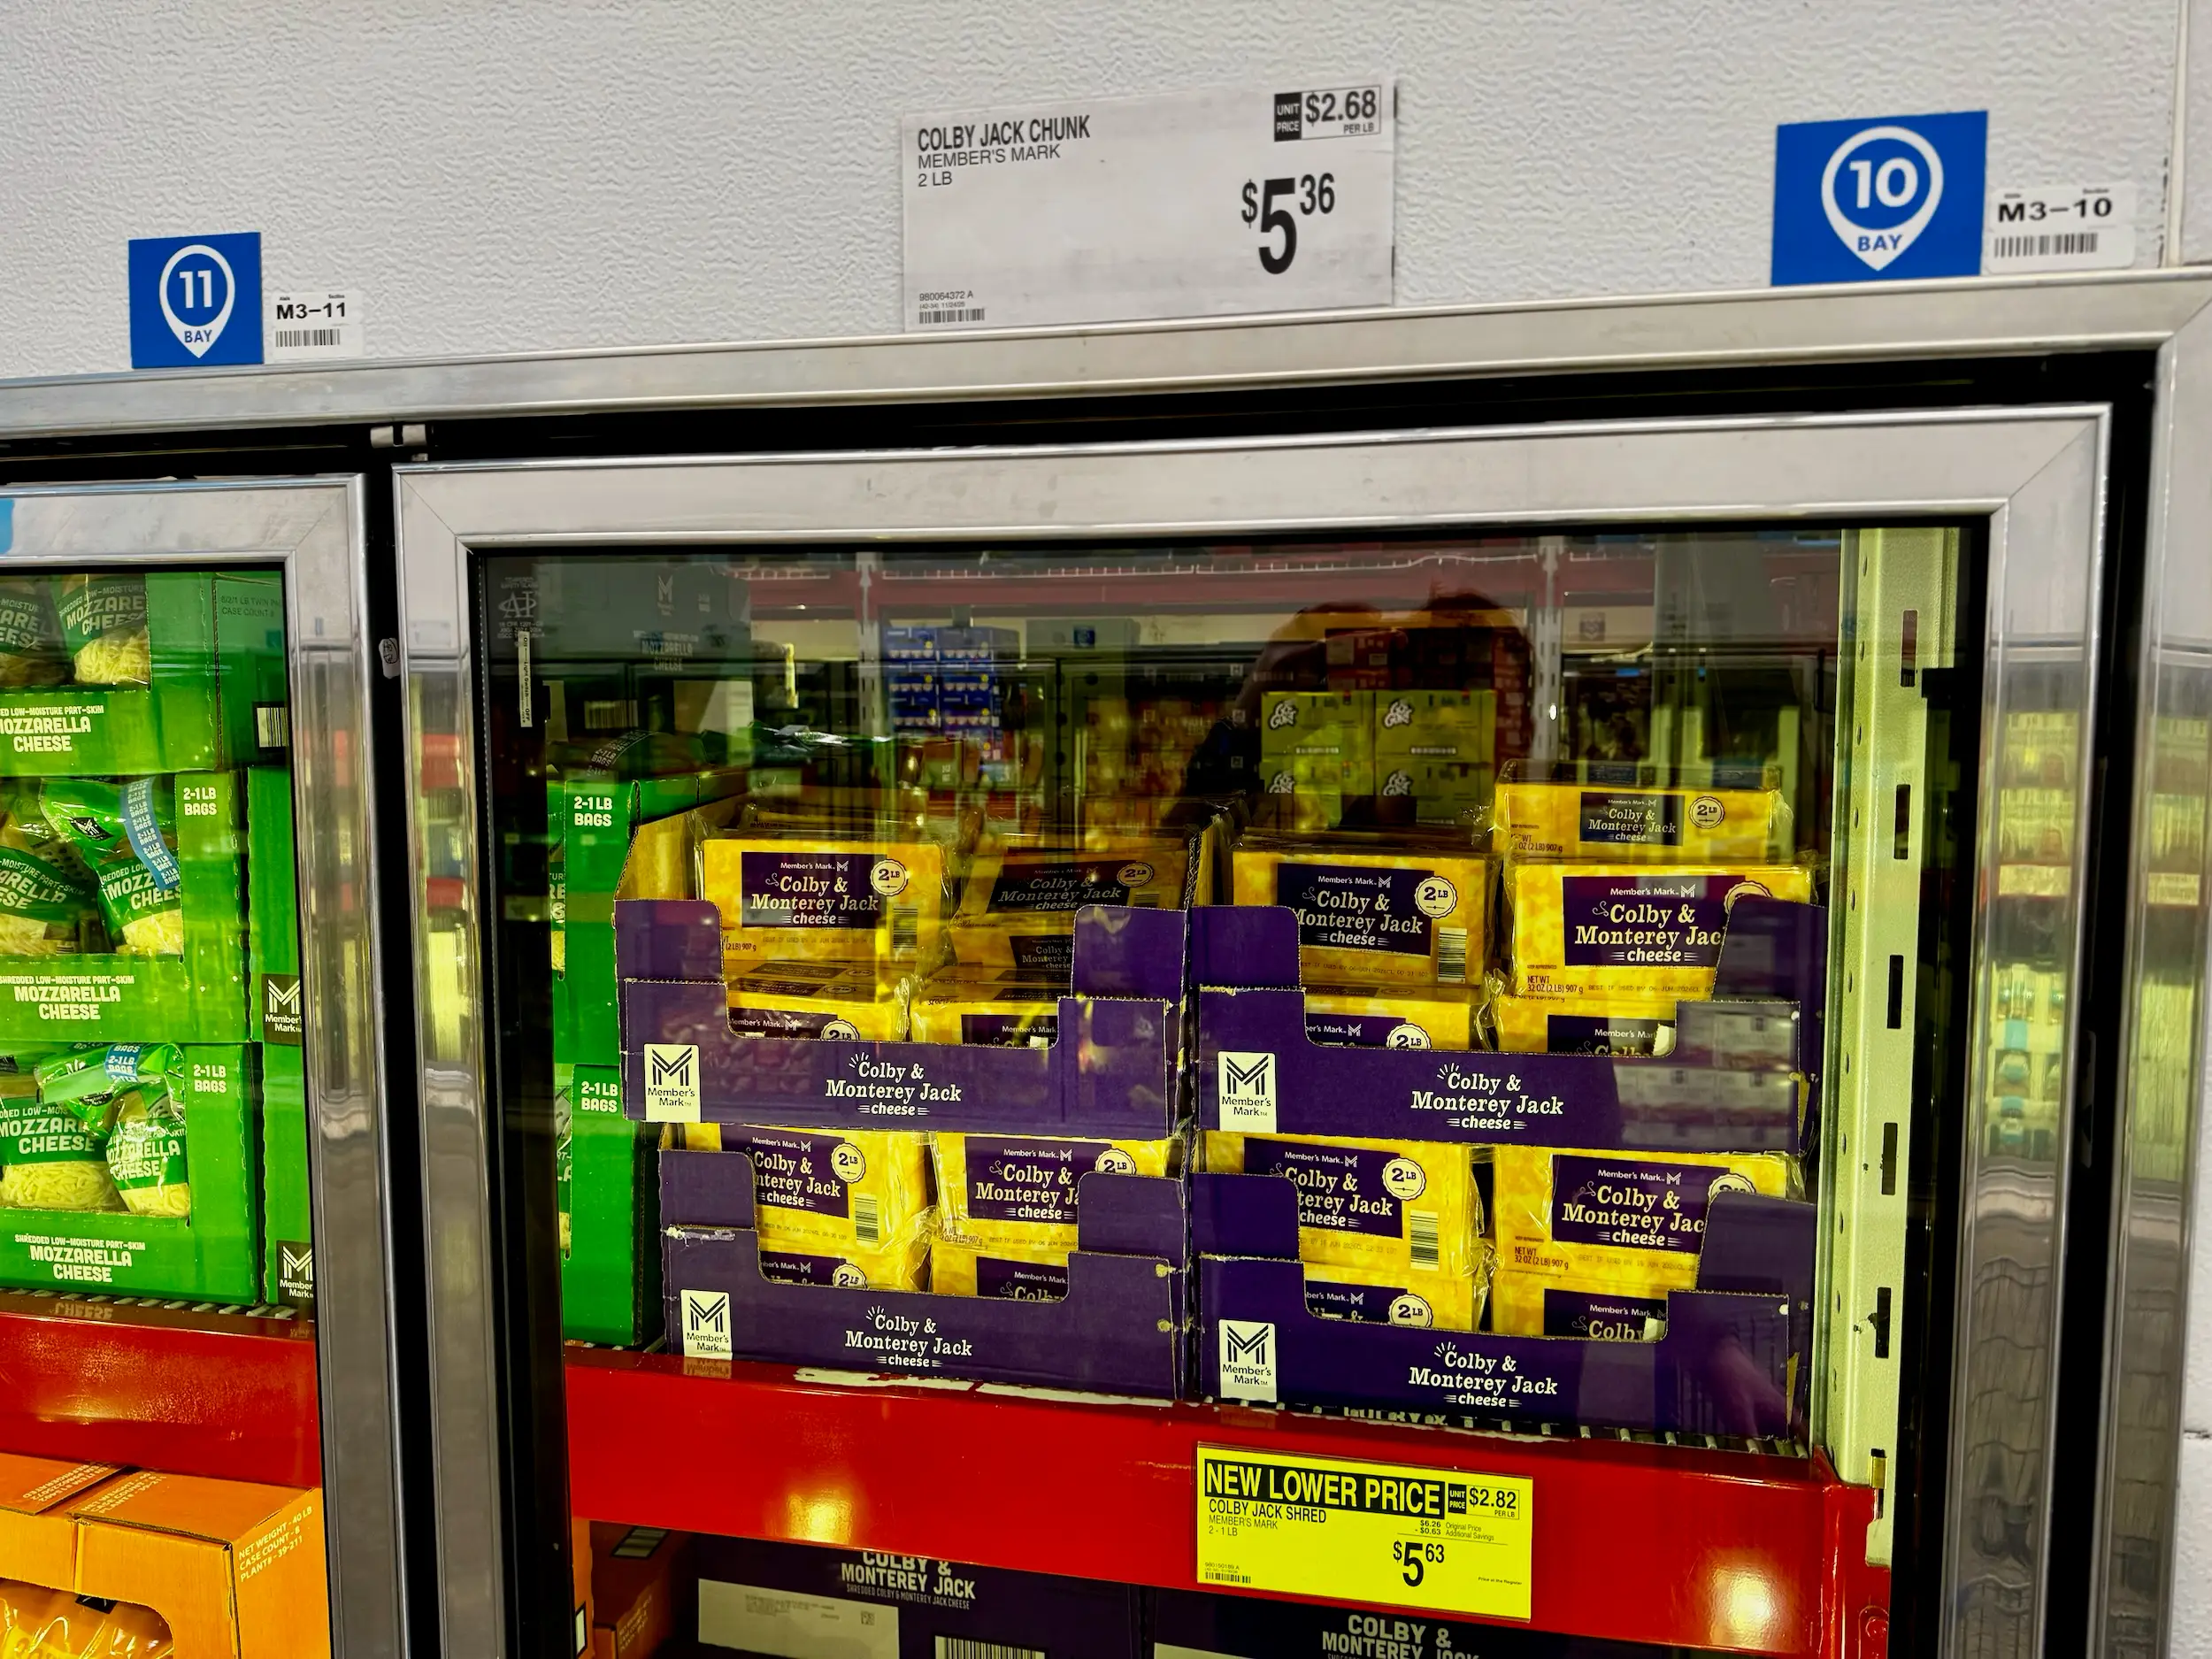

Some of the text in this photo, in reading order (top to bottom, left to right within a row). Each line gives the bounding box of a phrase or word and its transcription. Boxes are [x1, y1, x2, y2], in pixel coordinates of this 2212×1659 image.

[1277, 103, 1300, 116] UNIT
[1305, 90, 1376, 126] $2.68
[918, 115, 1090, 152] COLBY JACK CHUNK
[1276, 119, 1299, 134] PRICE
[1343, 123, 1374, 134] PER LB
[918, 144, 1060, 169] MEMBER'S MARK
[918, 172, 952, 187] 2 LB
[1849, 157, 1918, 209] 10
[1998, 197, 2112, 223] M3-10
[1858, 234, 1903, 252] BAY
[180, 270, 212, 308] 11
[276, 302, 346, 320] M3-11
[184, 330, 213, 343] BAY
[13, 735, 73, 752] CHEESE
[184, 803, 217, 815] BAGS
[575, 813, 612, 826] BAGS
[1588, 820, 1677, 834] Monterey Jack
[780, 876, 848, 895] Colby &
[998, 887, 1121, 902] Monterey Jack
[1317, 890, 1390, 910] Colby &
[751, 894, 879, 914] Monterey Jack
[793, 912, 836, 925] cheese
[1380, 914, 1423, 933] Jack
[1609, 904, 1695, 927] Colby &
[1330, 931, 1376, 946] cheese
[1626, 947, 1681, 962] cheese
[1527, 975, 1549, 984] NET WT
[14, 986, 121, 1002] MOZZARELLA
[1528, 984, 1537, 993] 32
[1538, 984, 1547, 993] OZ
[1565, 984, 1576, 994] 907
[39, 1003, 101, 1020] CHEESE
[274, 1023, 296, 1032] Mark
[858, 1062, 924, 1084] Colby &
[195, 1080, 227, 1093] BAGS
[826, 1079, 962, 1104] Monterey Jack
[1447, 1071, 1521, 1095] Colby &
[648, 1087, 695, 1098] Member's
[581, 1098, 618, 1113] BAGS
[871, 1102, 916, 1116] cheese
[1222, 1096, 1271, 1107] Member's
[1410, 1091, 1564, 1118] Monterey Jack
[1461, 1115, 1511, 1130] cheese
[754, 1151, 812, 1177] Colby &
[1002, 1164, 1072, 1187] Colby &
[1284, 1167, 1358, 1192] Colby &
[766, 1191, 805, 1208] cheese
[1596, 1186, 1680, 1211] Colby &
[1018, 1205, 1062, 1219] cheese
[1300, 1211, 1346, 1227] cheese
[15, 1233, 146, 1250] SHREDDED LOW-MOISTURE PART-SKIM
[1612, 1228, 1665, 1247] cheese
[30, 1246, 132, 1266] MOZZARELLA
[53, 1264, 112, 1283] CHEESE
[874, 1314, 936, 1333] Colby &
[687, 1333, 729, 1343] Member's
[845, 1331, 972, 1356] Monterey Jack
[887, 1354, 930, 1368] cheese
[1444, 1350, 1516, 1375] Colby &
[1223, 1364, 1271, 1376] Member's
[1409, 1367, 1557, 1395] Monterey Jack
[1458, 1393, 1506, 1407] cheese
[1206, 1463, 1440, 1516] NEW LOWER PRICE
[1449, 1490, 1465, 1499] UNIT
[1469, 1486, 1517, 1509] $2.82
[1210, 1499, 1326, 1524] COLBY JACK SHRED
[1449, 1501, 1465, 1509] PRICE
[1209, 1515, 1278, 1530] MEMBER'S MARK
[1420, 1519, 1441, 1528] $6.26
[1446, 1522, 1466, 1532] Original
[239, 1506, 312, 1561] NET WEIGHT 40 LB
[1227, 1527, 1238, 1536] LB
[1446, 1530, 1471, 1539] Additional
[1473, 1532, 1494, 1541] Savings
[240, 1551, 261, 1571] CASE
[262, 1532, 289, 1555] COUNT
[841, 1563, 976, 1599] MONTEREY JACK
[847, 1584, 875, 1596] SHREDDED
[877, 1586, 895, 1599] COLBY
[901, 1592, 931, 1605] MONTEREY
[933, 1595, 947, 1607] JACK
[949, 1598, 970, 1610] CHEESE
[1348, 1615, 1452, 1647] COLBY &
[1322, 1631, 1424, 1659] MONTEREY
